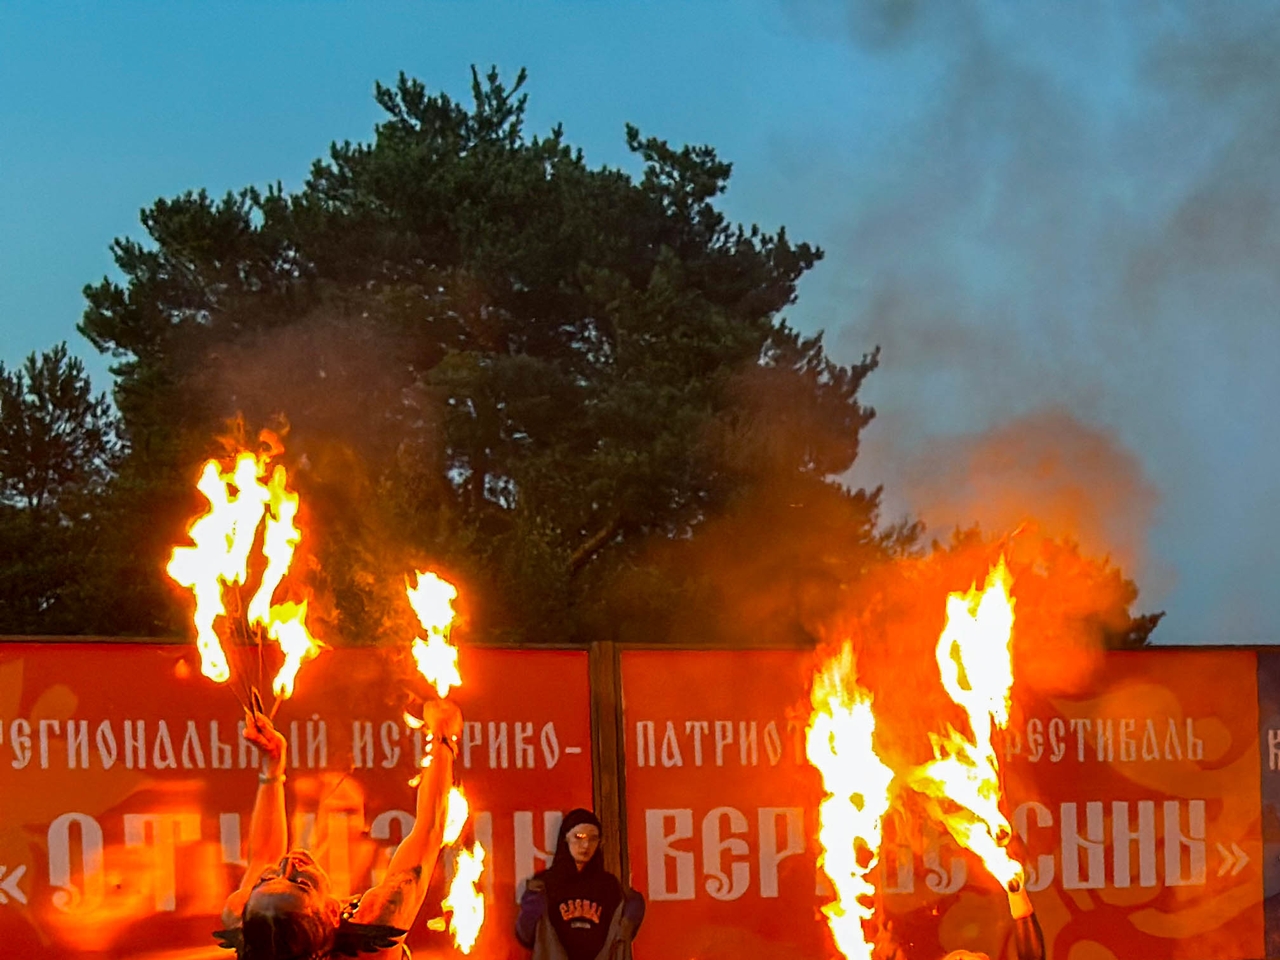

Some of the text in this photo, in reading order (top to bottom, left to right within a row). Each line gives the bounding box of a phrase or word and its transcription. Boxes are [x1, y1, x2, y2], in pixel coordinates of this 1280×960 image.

[0, 713, 582, 770] ЕГИОНАЛЬНЙ ИСТРИКО-
[636, 720, 808, 768] ПАТРИОТ
